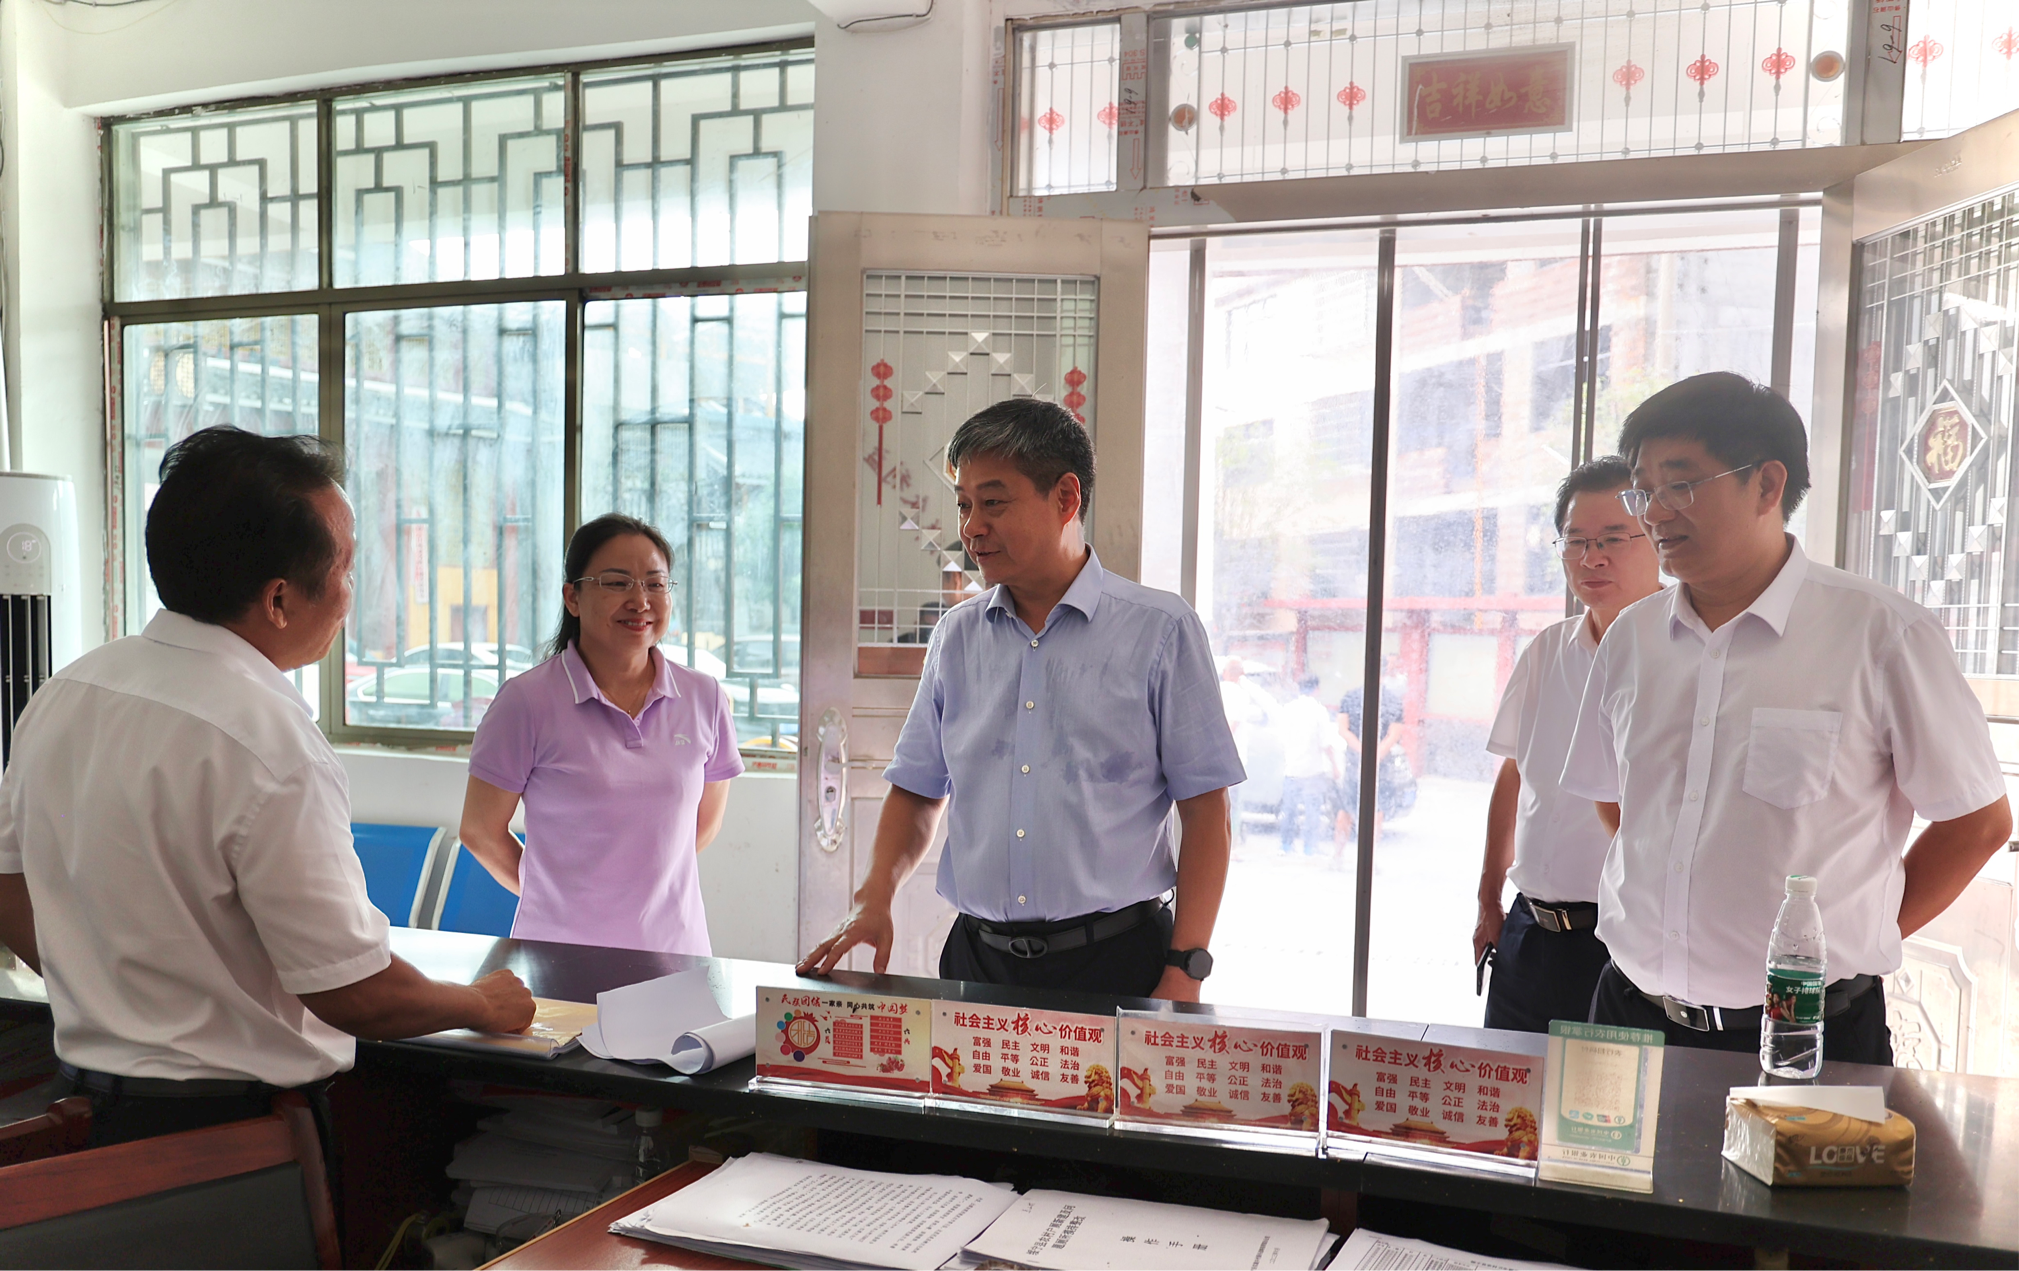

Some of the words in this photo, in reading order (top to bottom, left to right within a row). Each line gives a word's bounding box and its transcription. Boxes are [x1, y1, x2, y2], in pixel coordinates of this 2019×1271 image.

[1421, 65, 1549, 120] 吉祥如意
[954, 1012, 1102, 1043] 社会主义核心价值观
[973, 1037, 992, 1048] 富强
[1001, 1040, 1020, 1051] 民主
[1030, 1043, 1049, 1054] 文明
[1060, 1046, 1080, 1057] 和谐
[1145, 1030, 1307, 1061] 社会主义核心价值观
[972, 1050, 990, 1061] 自由
[1001, 1053, 1020, 1064] 平等
[1030, 1056, 1048, 1067] 公正
[1060, 1059, 1080, 1070] 法治
[1165, 1056, 1186, 1067] 富强
[1197, 1058, 1217, 1070] 民主
[1229, 1061, 1250, 1072] 文明
[1261, 1064, 1282, 1075] 和谐
[1356, 1045, 1528, 1084] 社会主义核心价值观
[973, 1064, 992, 1075] 爱国
[1001, 1067, 1021, 1078] 敬业
[1031, 1069, 1050, 1081] 诚信
[1060, 1073, 1080, 1084] 友善
[1165, 1070, 1184, 1081] 自由
[1196, 1072, 1216, 1084] 平等
[1228, 1075, 1248, 1086] 公正
[1261, 1078, 1282, 1089] 法治
[1376, 1072, 1398, 1084] 富强
[1410, 1076, 1431, 1088] 民主
[1443, 1080, 1466, 1093] 文明
[1478, 1085, 1500, 1098] 和谐
[1165, 1084, 1186, 1095] 爱国
[1196, 1086, 1217, 1097] 敬业
[1229, 1089, 1249, 1100] 诚信
[1261, 1092, 1282, 1103] 友善
[1375, 1086, 1396, 1098] 自由
[1408, 1091, 1430, 1102] 平等
[1442, 1095, 1464, 1108] 公正
[1477, 1100, 1500, 1112] 法治
[1375, 1101, 1397, 1113] 爱国
[1408, 1105, 1430, 1117] 敬业
[1442, 1110, 1464, 1122] 诚信
[1476, 1115, 1499, 1127] 友善
